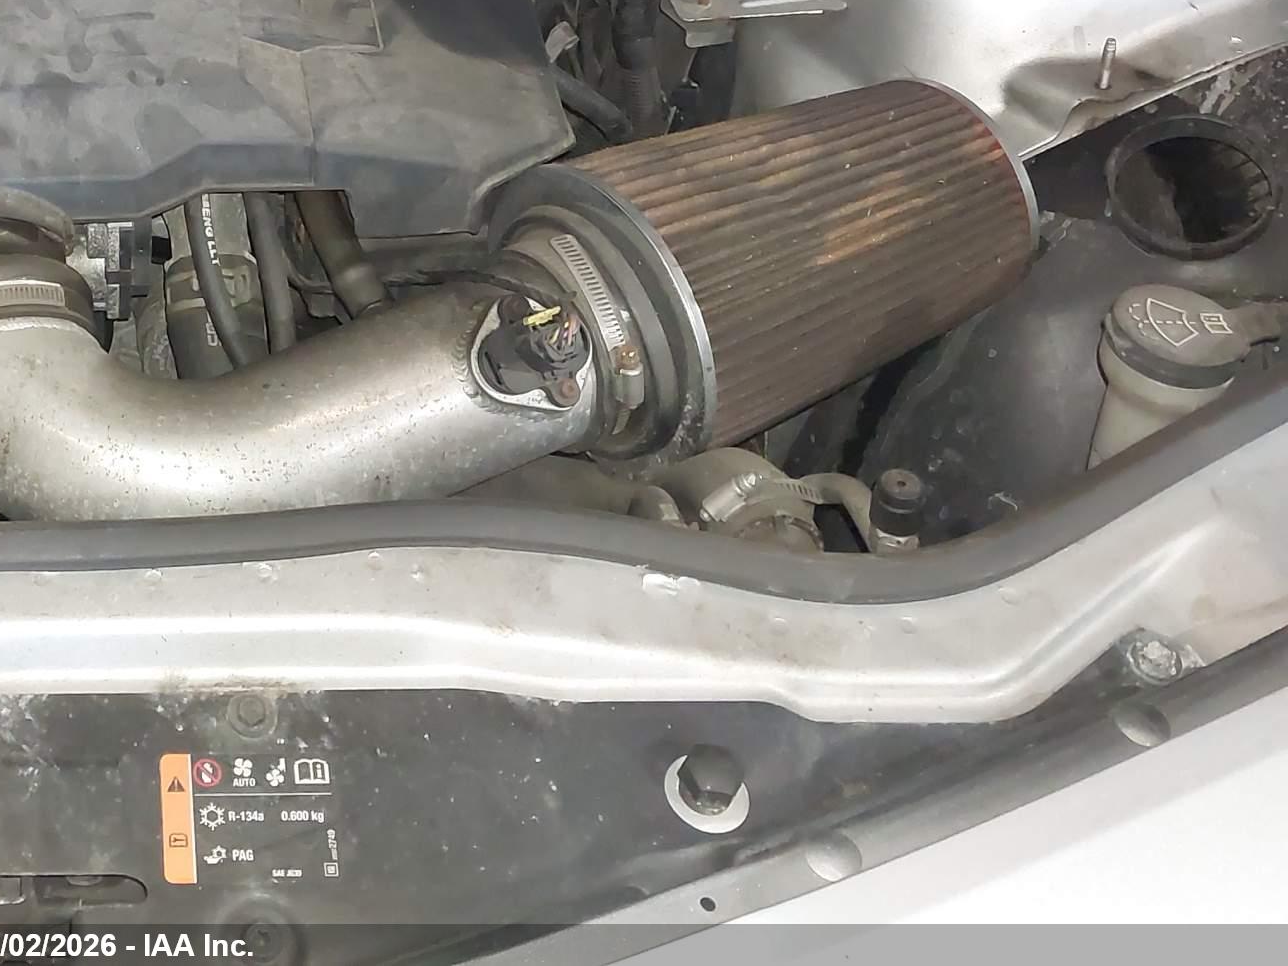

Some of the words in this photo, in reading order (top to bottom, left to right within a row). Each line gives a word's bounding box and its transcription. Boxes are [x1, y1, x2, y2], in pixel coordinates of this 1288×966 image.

[232, 778, 256, 787] AUTO
[228, 810, 264, 821] R-134a
[281, 811, 309, 821] 0.600
[311, 810, 325, 823] kg
[232, 849, 254, 862] PAG
